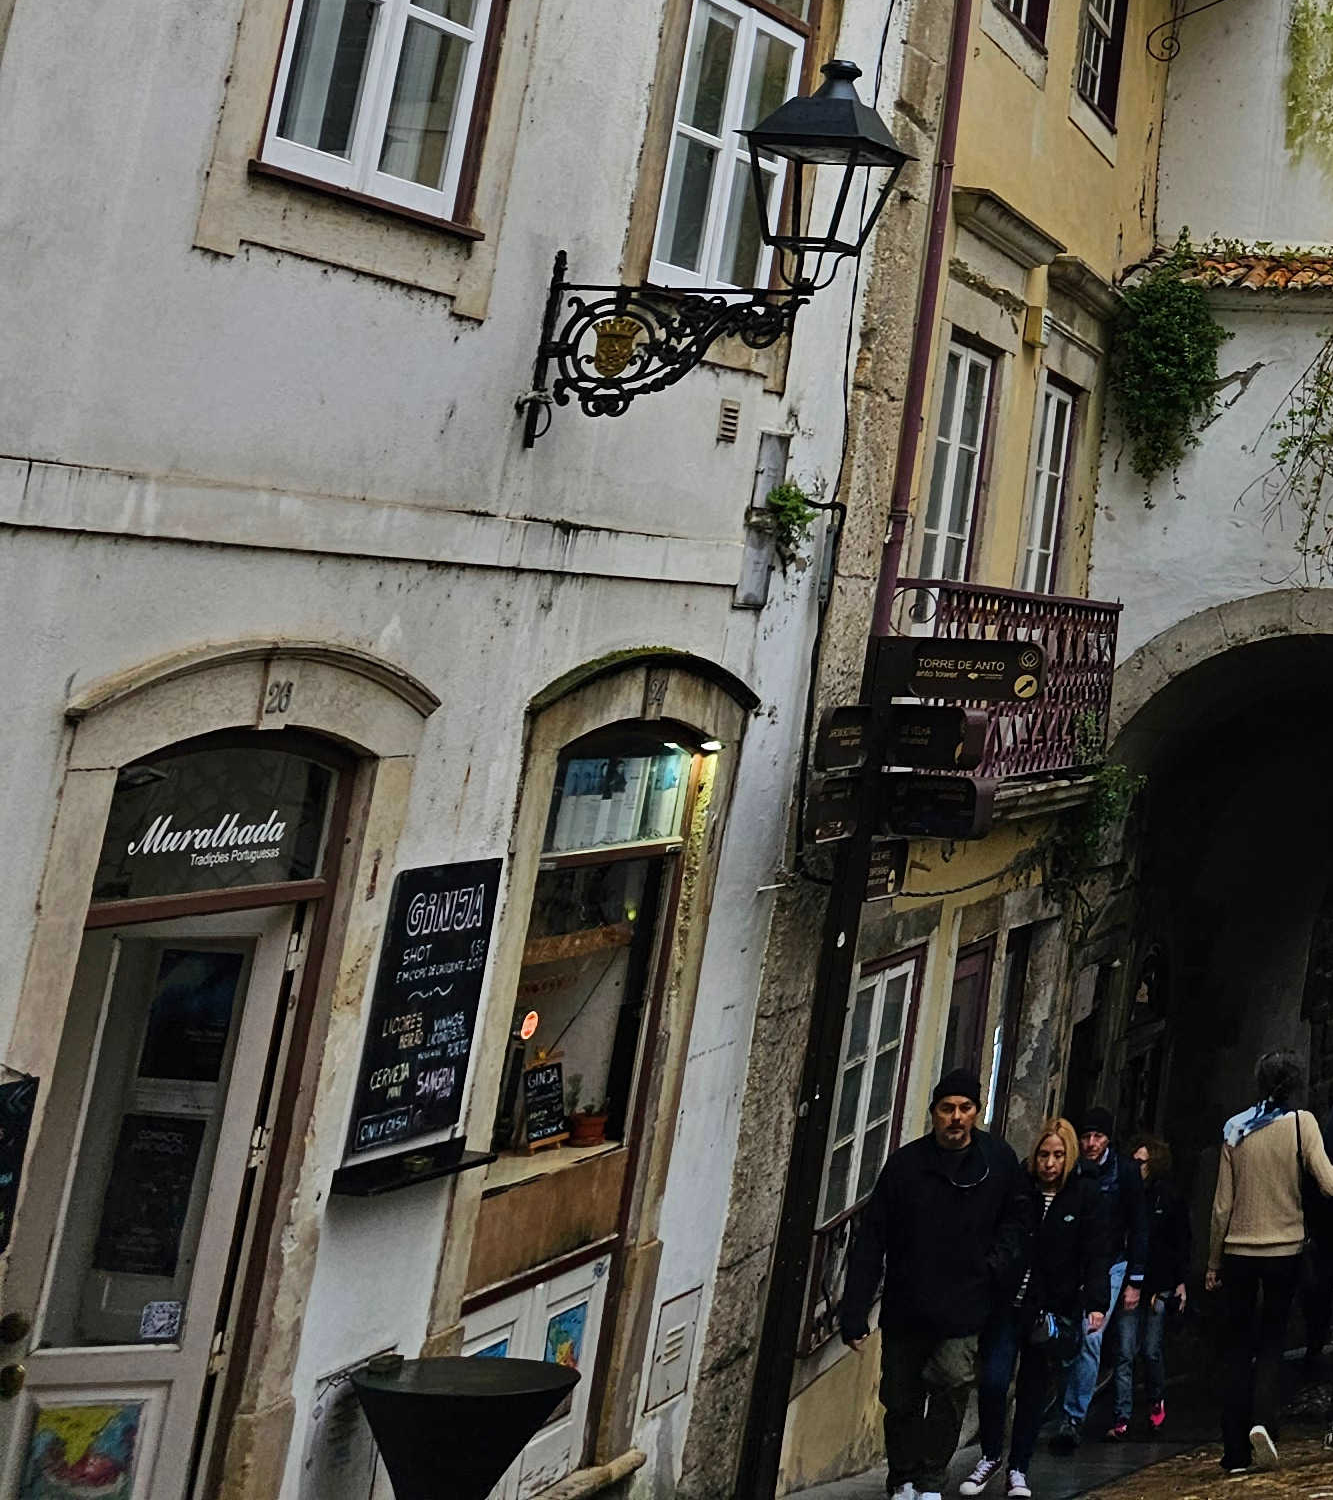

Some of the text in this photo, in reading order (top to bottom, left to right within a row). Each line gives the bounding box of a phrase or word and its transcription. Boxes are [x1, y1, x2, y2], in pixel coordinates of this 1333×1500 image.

[918, 658, 1005, 671] TORRE DE ANTO
[264, 680, 294, 714] 26
[128, 810, 286, 856] Muralhada
[190, 847, 280, 868] Tradições Portuguesas
[402, 944, 432, 966] SHOT
[382, 1012, 423, 1037] LICORES
[370, 1062, 410, 1091] CERVEJA
[416, 1066, 455, 1096] SANGRIA
